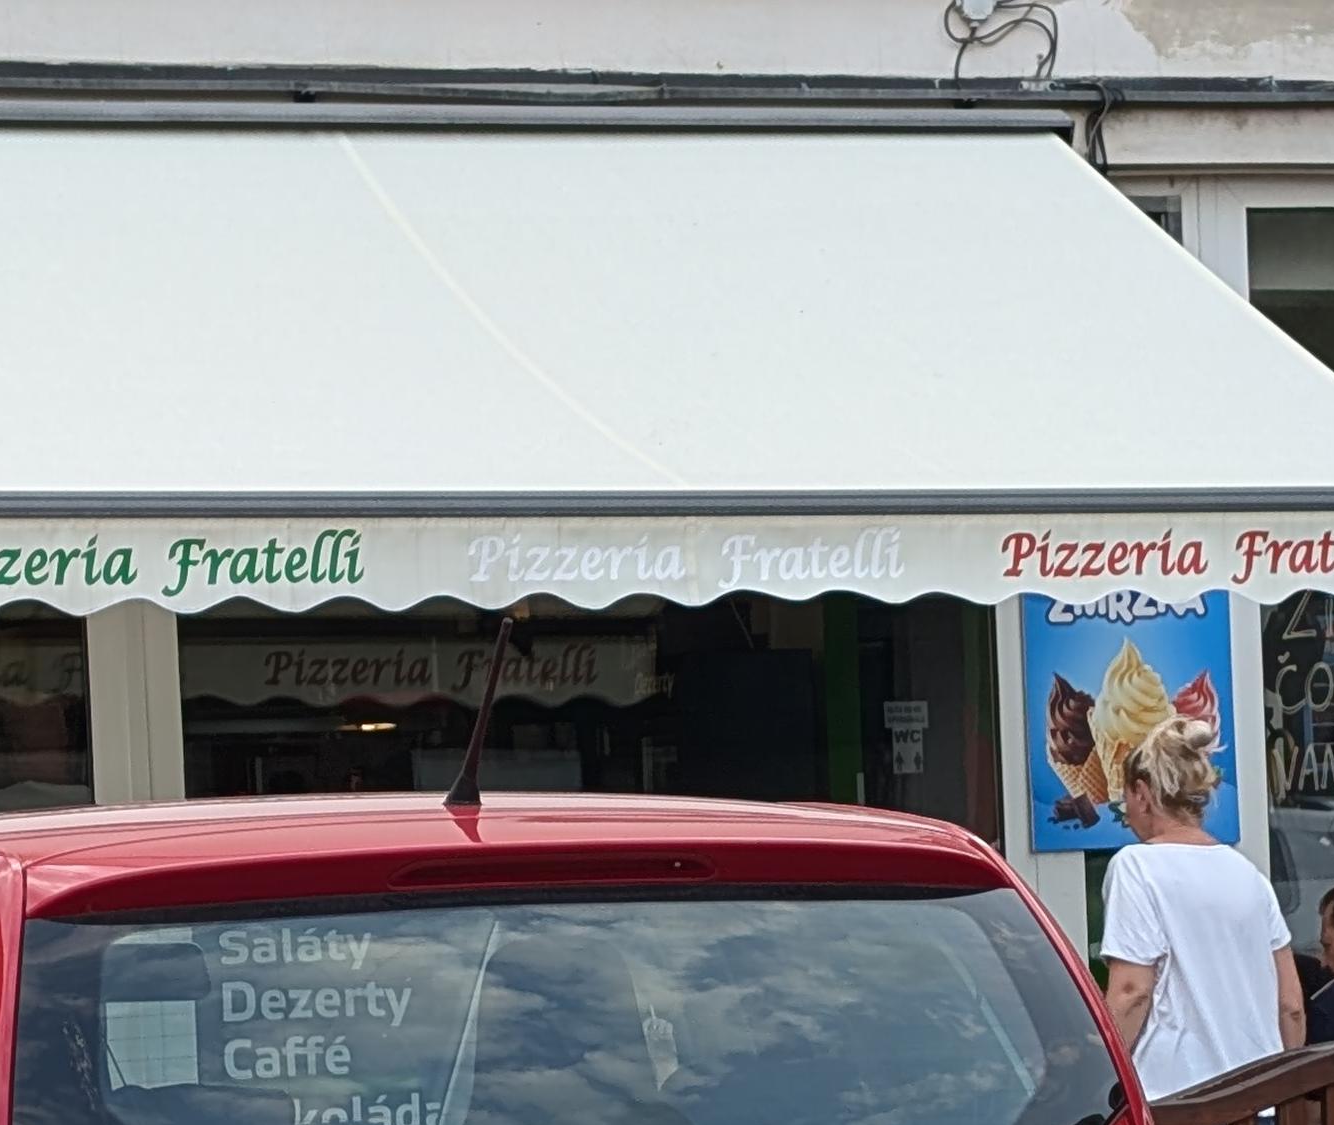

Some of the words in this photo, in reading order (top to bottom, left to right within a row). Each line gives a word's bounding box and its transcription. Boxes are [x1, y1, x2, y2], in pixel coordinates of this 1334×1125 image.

[162, 528, 365, 597] Fratelli
[467, 531, 687, 583] Pizzeria
[717, 524, 906, 589] Fratelli
[1001, 527, 1209, 578] Pizzeria
[219, 927, 372, 970] Saláty
[222, 980, 412, 1027] Dezerty
[224, 1036, 352, 1081] Caffé
